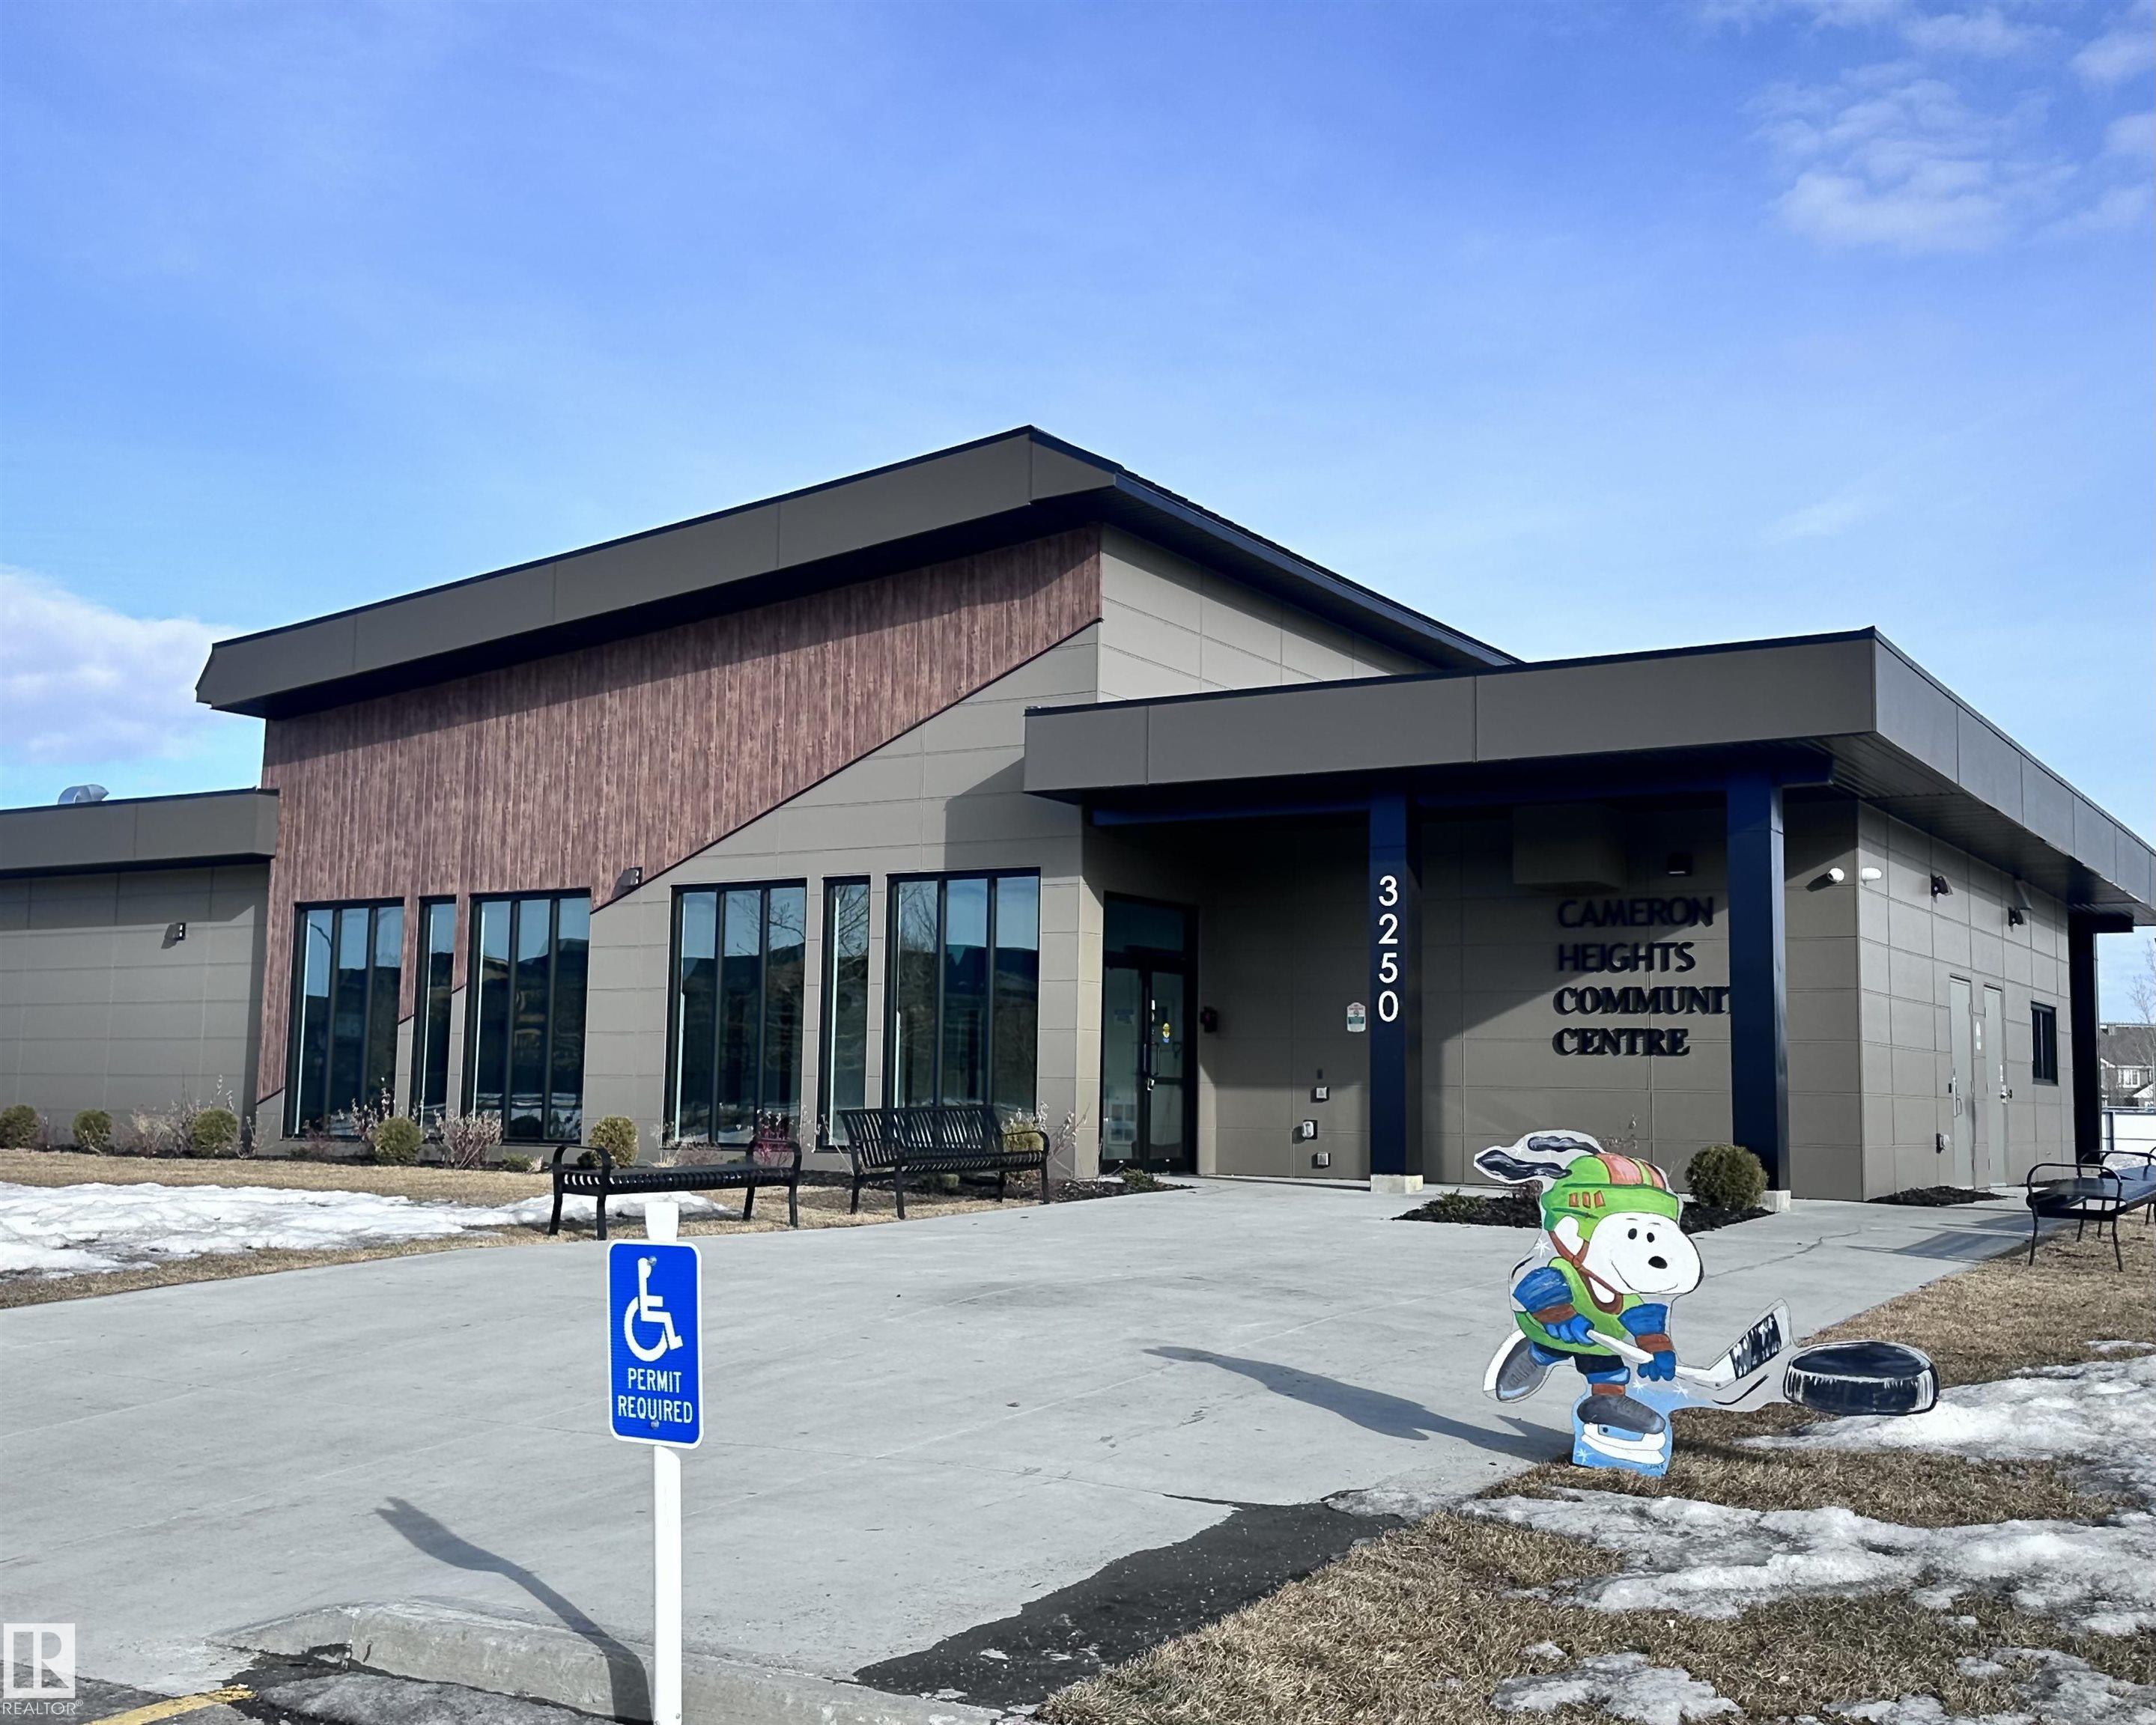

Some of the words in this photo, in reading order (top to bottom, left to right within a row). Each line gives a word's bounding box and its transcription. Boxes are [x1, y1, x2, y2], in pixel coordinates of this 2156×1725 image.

[1557, 896, 1714, 928] CAMERON
[1378, 875, 1399, 1022] 3250
[1557, 941, 1696, 973] HEIGHTS
[1552, 986, 1731, 1015] COMMUNI
[1552, 1027, 1691, 1056] CENTRE
[628, 1367, 682, 1393] PERMIT
[617, 1395, 693, 1424] REQUIRED
